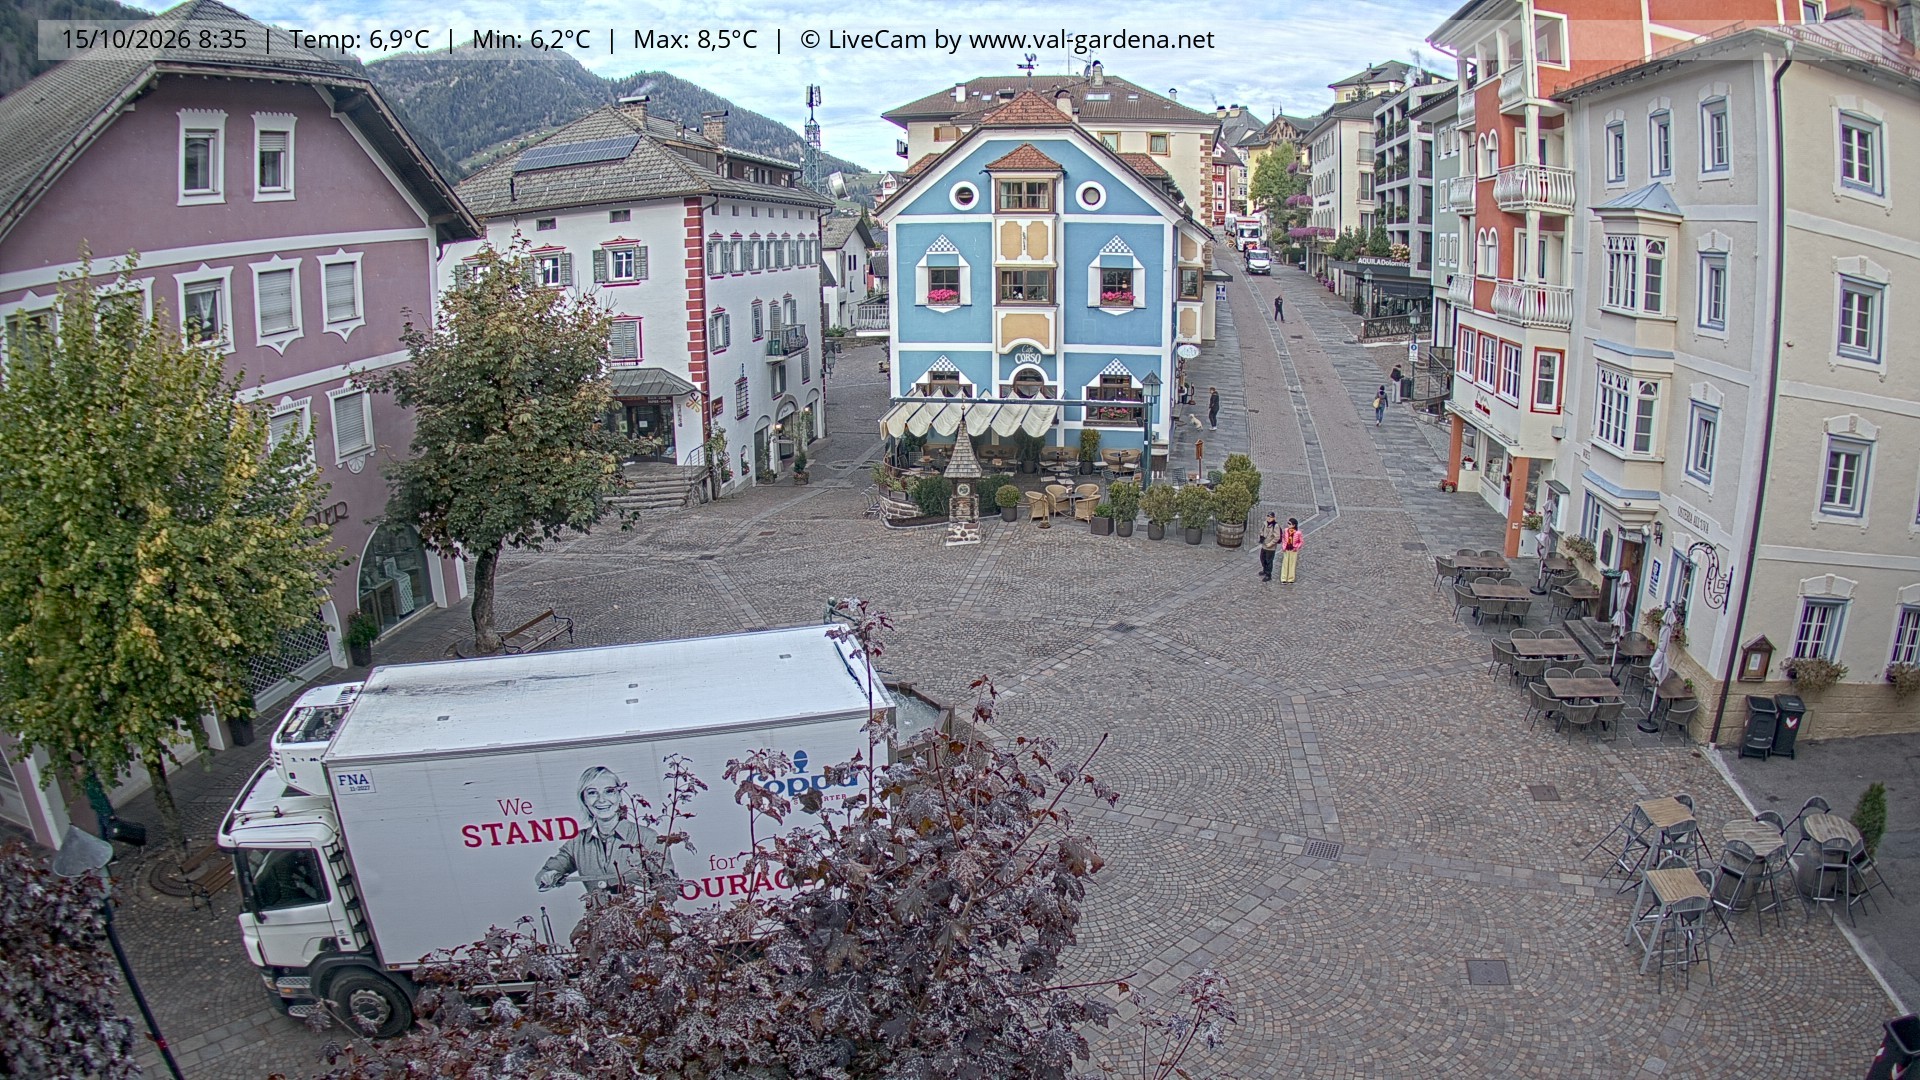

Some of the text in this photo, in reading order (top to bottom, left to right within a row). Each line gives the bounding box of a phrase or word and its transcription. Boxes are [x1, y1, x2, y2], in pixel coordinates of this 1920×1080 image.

[1015, 353, 1041, 364] CORSO
[337, 774, 369, 785] FNA
[496, 797, 534, 817] We
[461, 816, 580, 848] STAND
[708, 853, 737, 872] for
